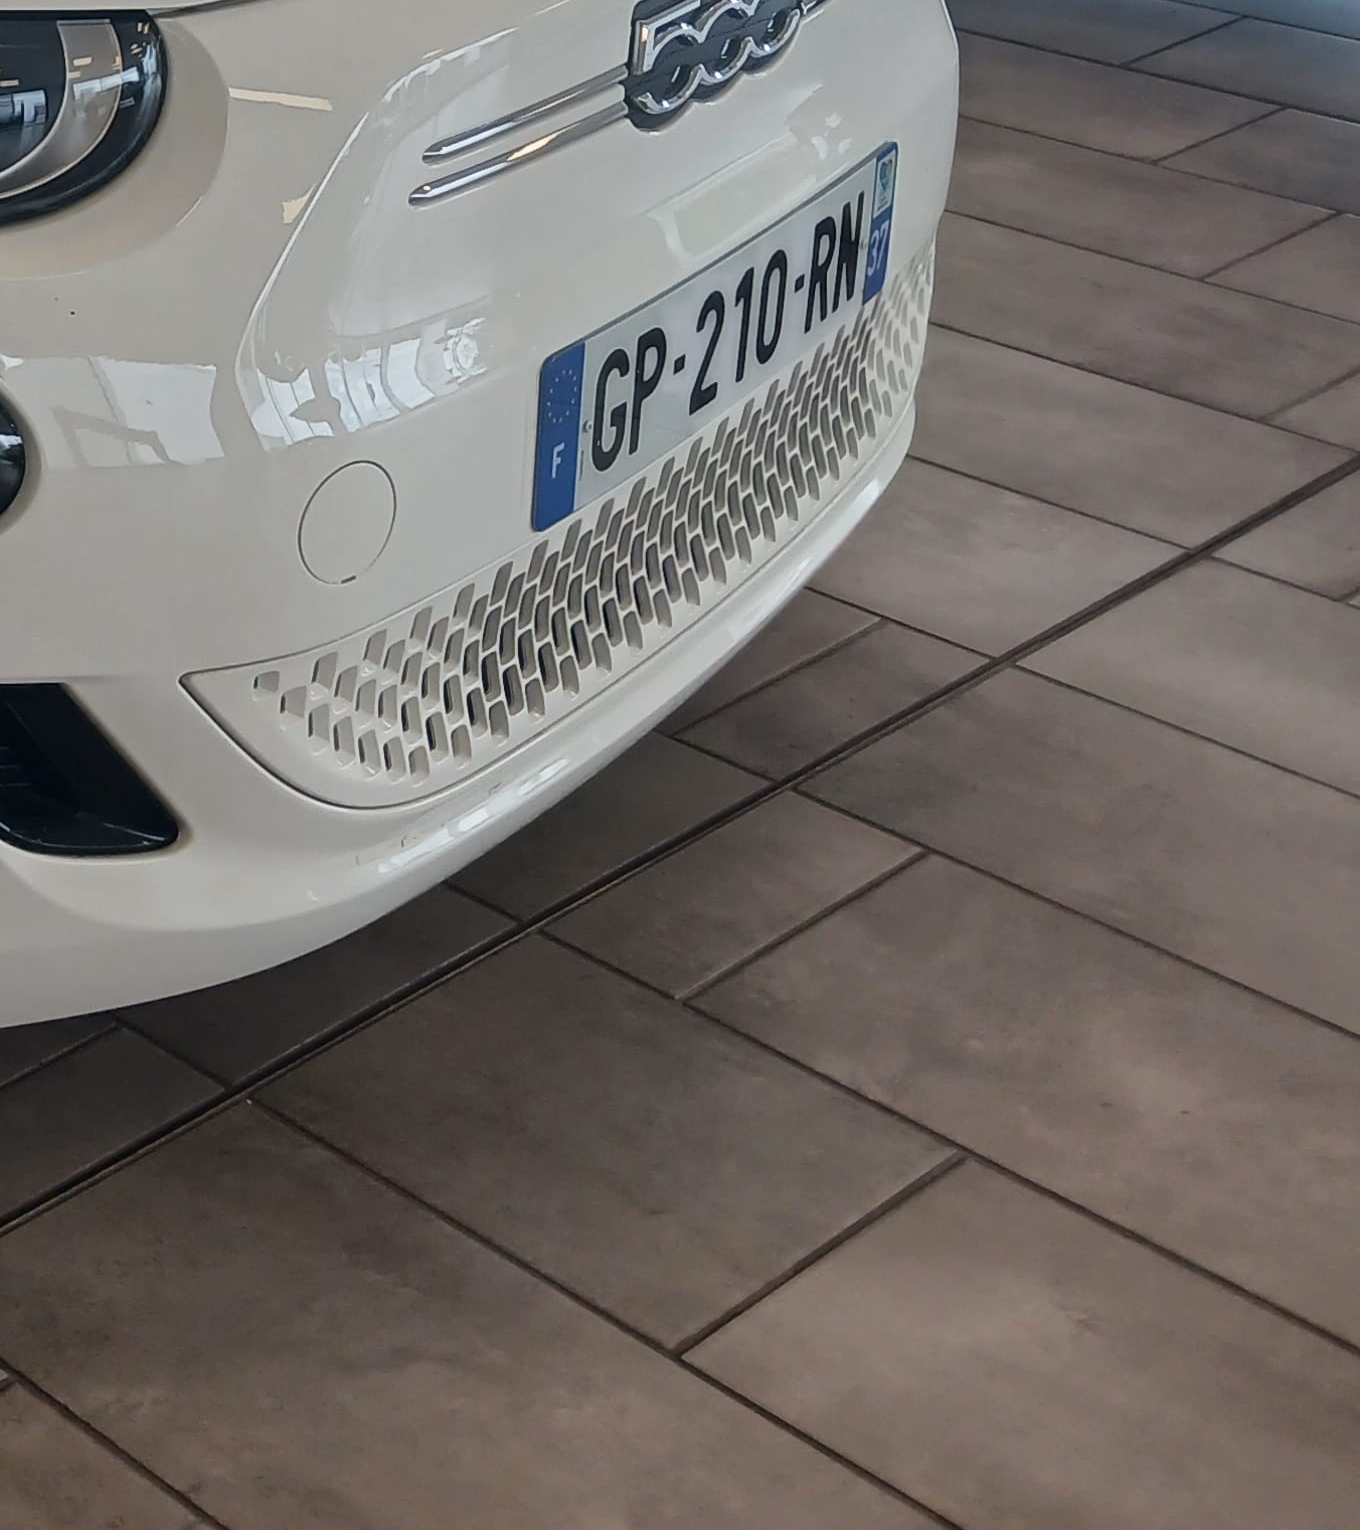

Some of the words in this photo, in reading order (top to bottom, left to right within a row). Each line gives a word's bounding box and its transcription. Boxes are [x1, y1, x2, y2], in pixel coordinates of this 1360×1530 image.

[868, 219, 890, 276] 37
[592, 189, 865, 472] GP-210-RN
[551, 442, 565, 479] F
